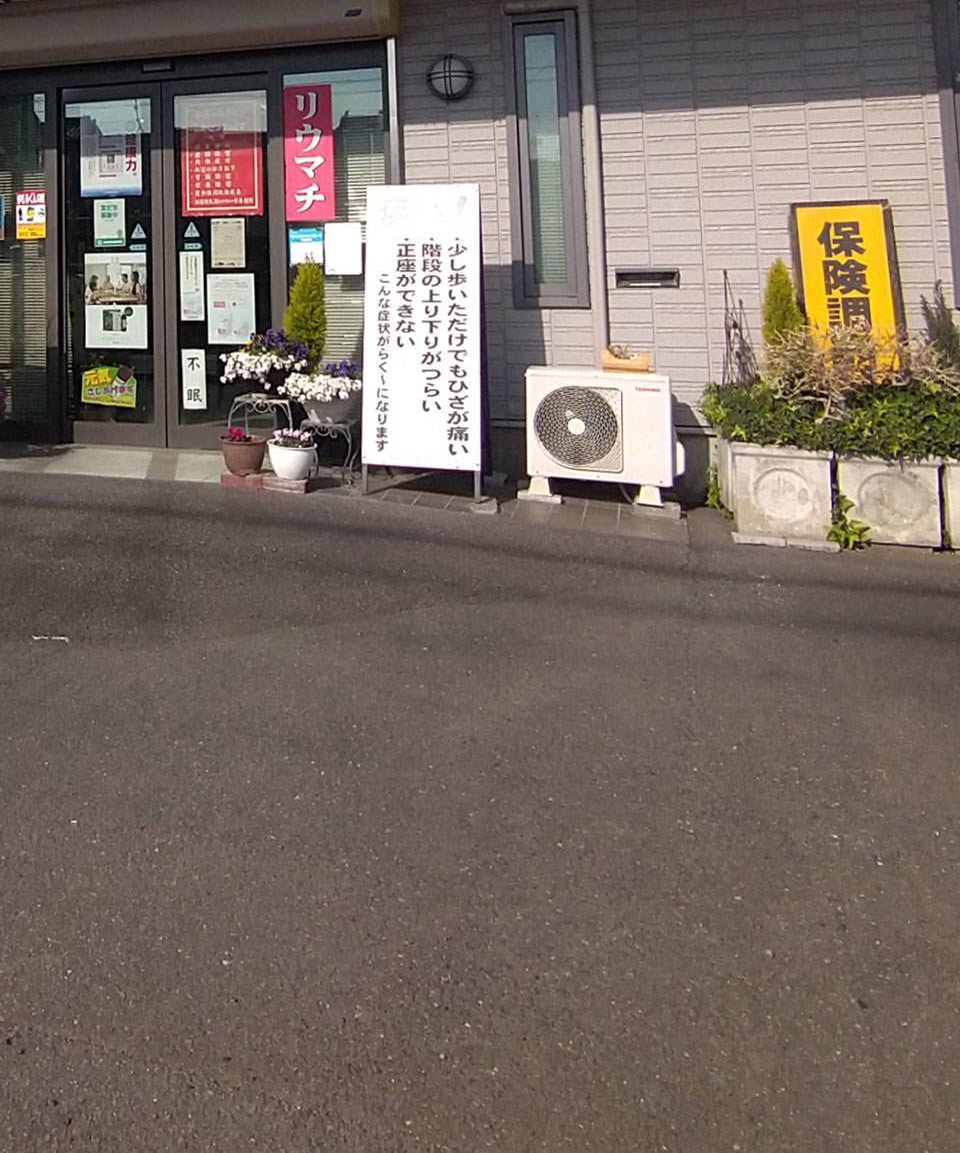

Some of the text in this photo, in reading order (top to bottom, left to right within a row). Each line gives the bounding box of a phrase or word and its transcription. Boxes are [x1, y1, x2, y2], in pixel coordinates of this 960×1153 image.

[294, 91, 326, 214] リウマチ
[187, 357, 202, 402] 不眠
